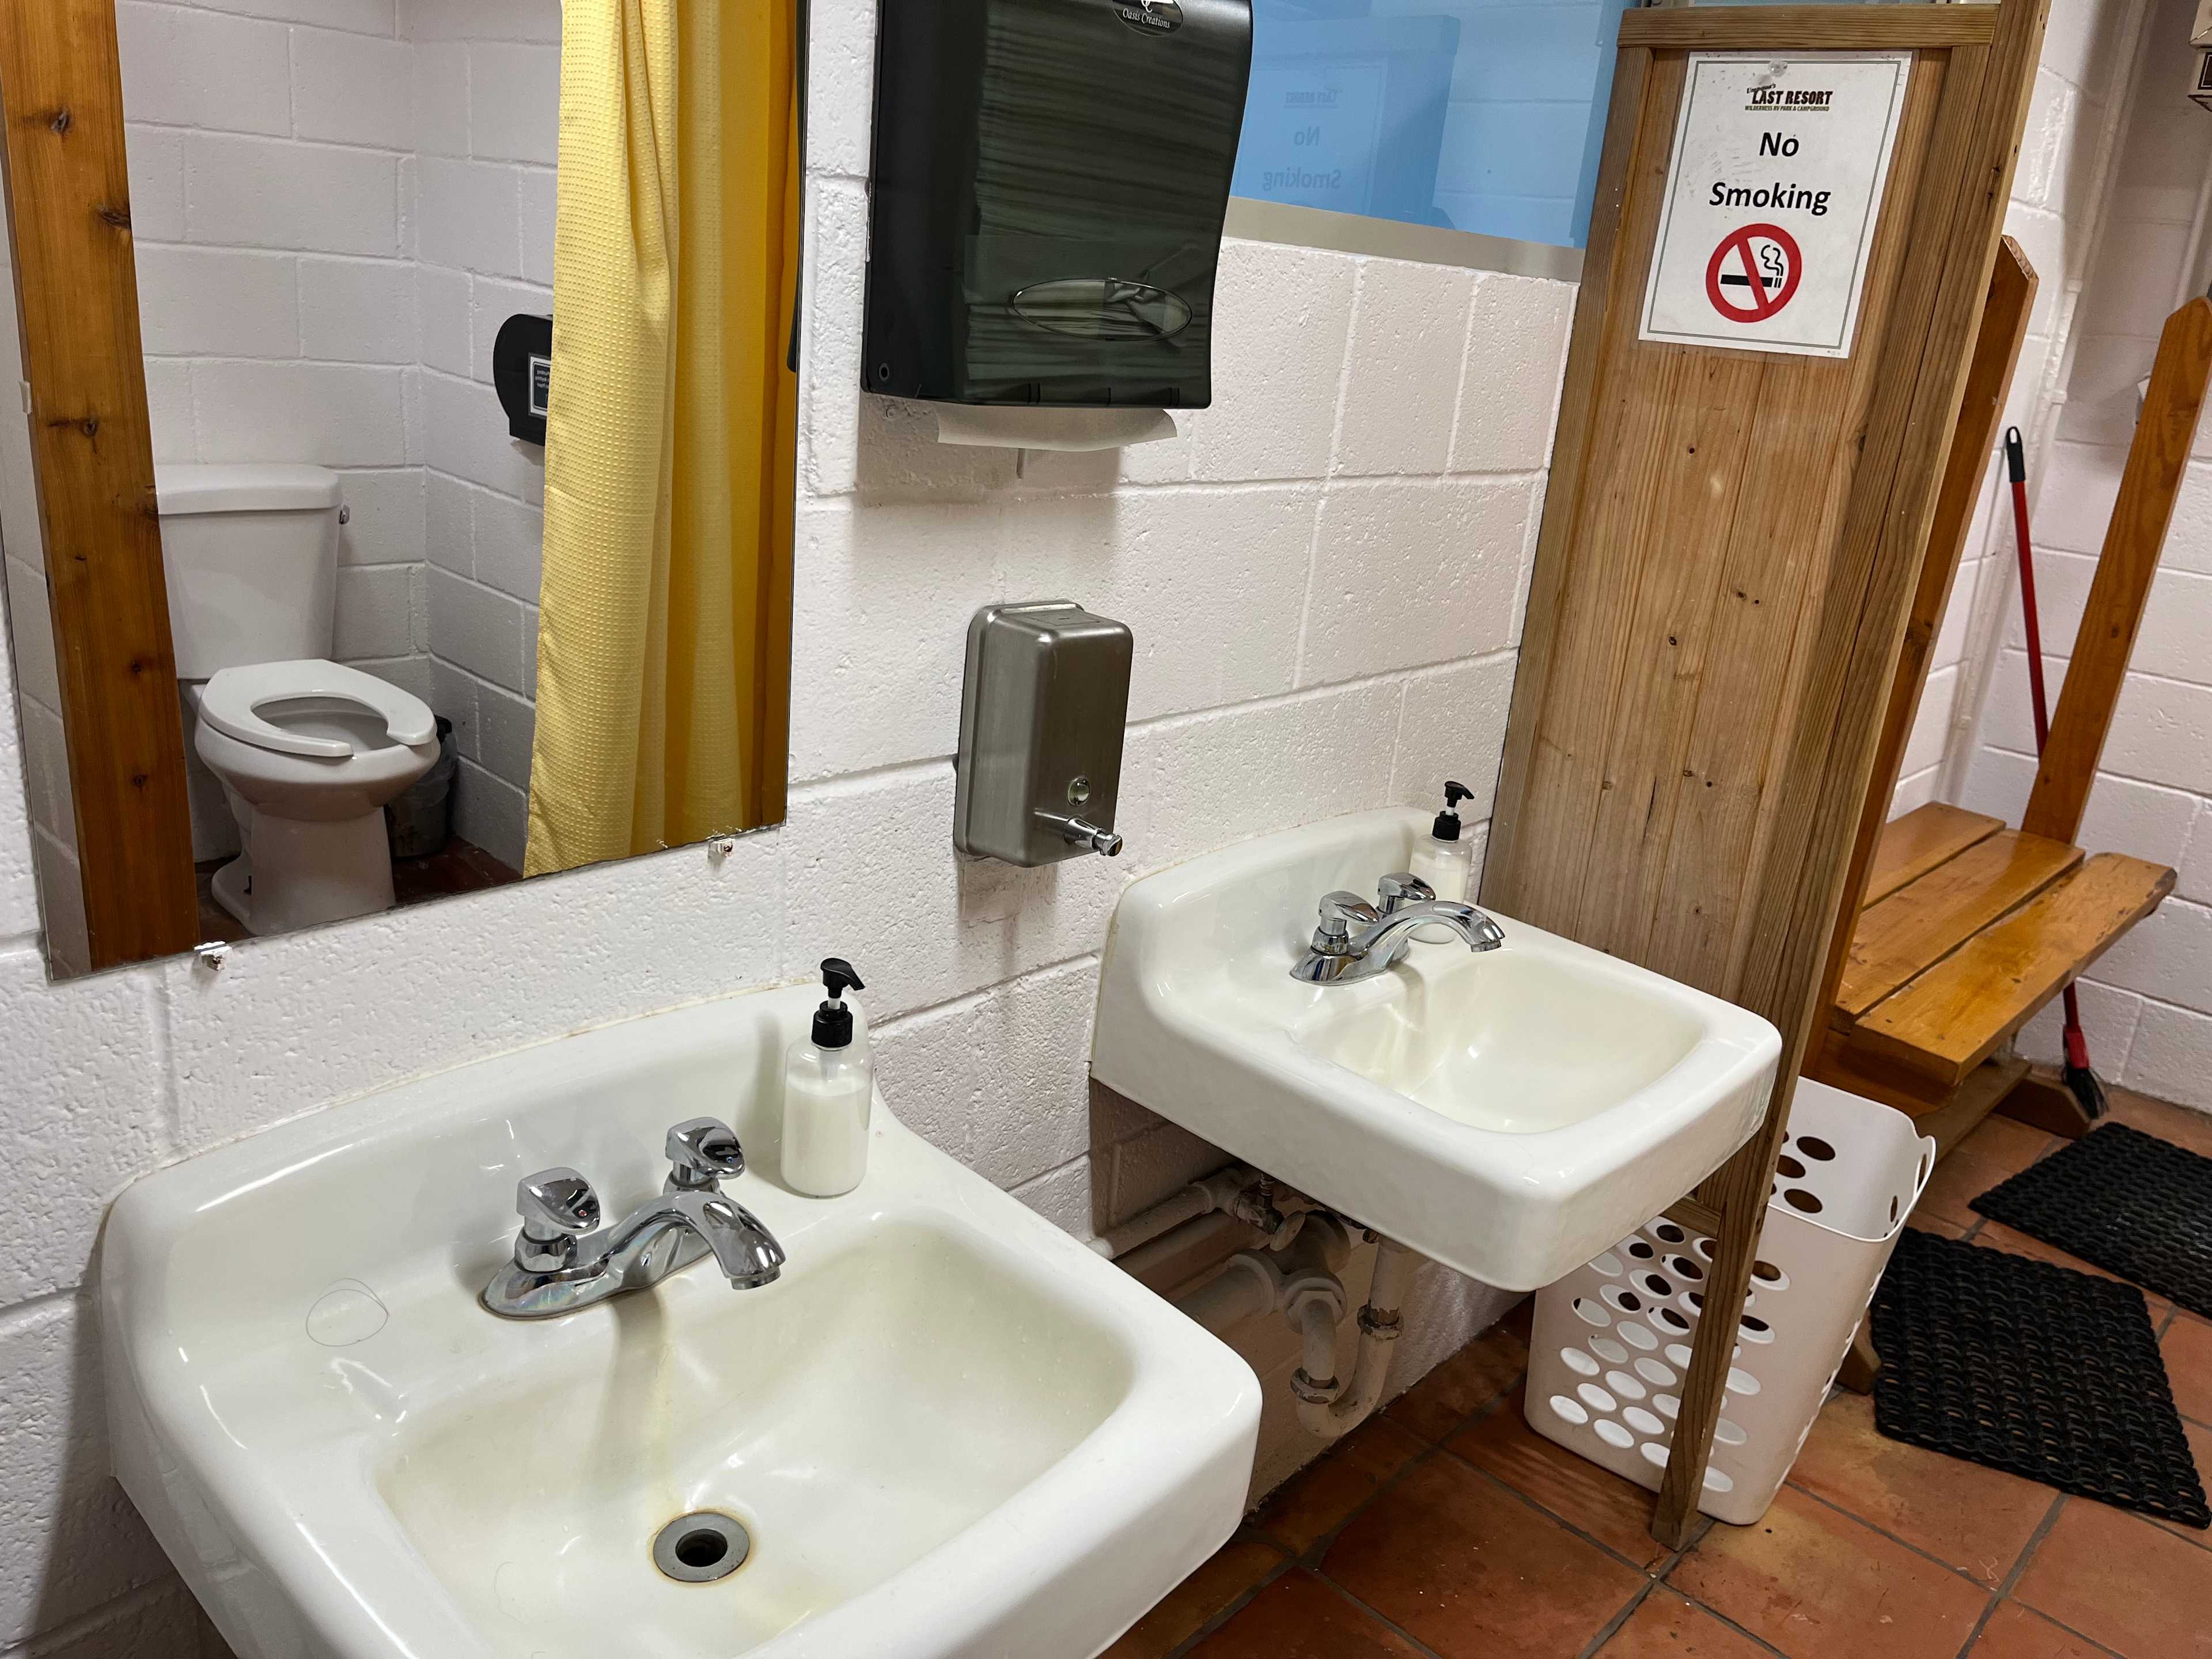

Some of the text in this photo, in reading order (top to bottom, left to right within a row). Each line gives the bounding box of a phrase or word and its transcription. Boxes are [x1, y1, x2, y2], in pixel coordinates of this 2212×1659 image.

[1123, 8, 1171, 28] Oasis Creations
[1752, 90, 1834, 105] LAST RESORT
[1759, 132, 1800, 157] No
[1709, 181, 1831, 216] Smoking
